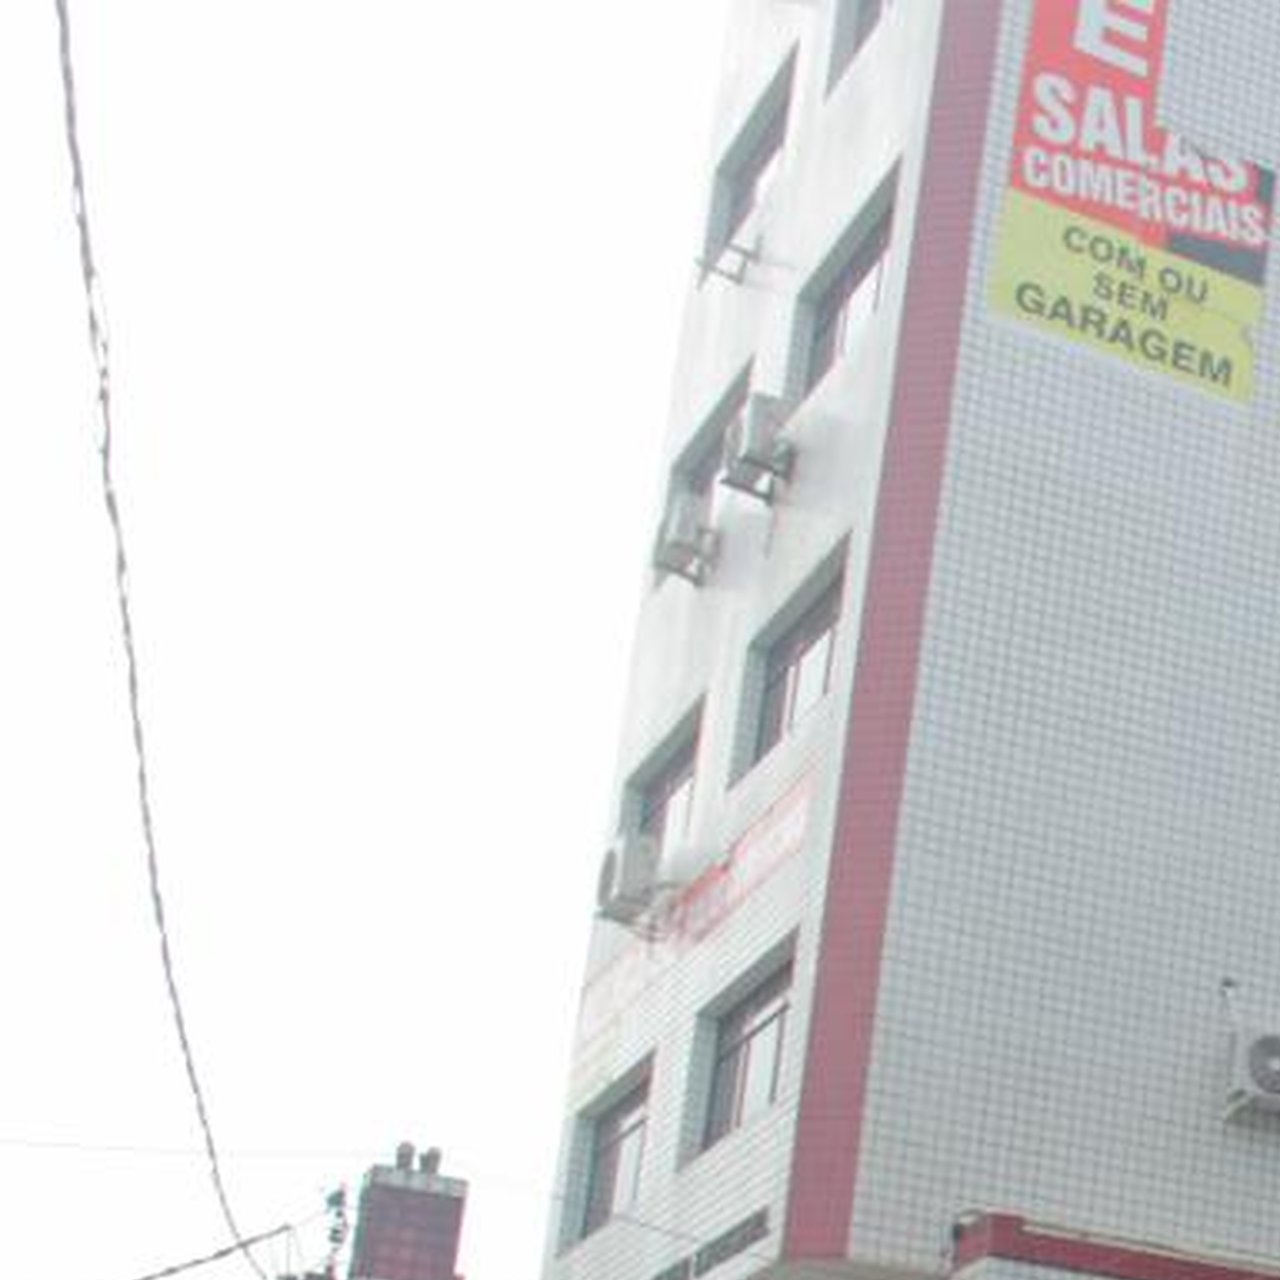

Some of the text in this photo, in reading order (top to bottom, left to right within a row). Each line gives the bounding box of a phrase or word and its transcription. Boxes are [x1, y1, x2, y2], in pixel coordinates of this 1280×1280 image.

[1023, 148, 1267, 245] COMERCIAIS
[1063, 226, 1208, 304] COM OU
[1093, 272, 1168, 321] SEM
[1015, 282, 1233, 387] GARAGEM
